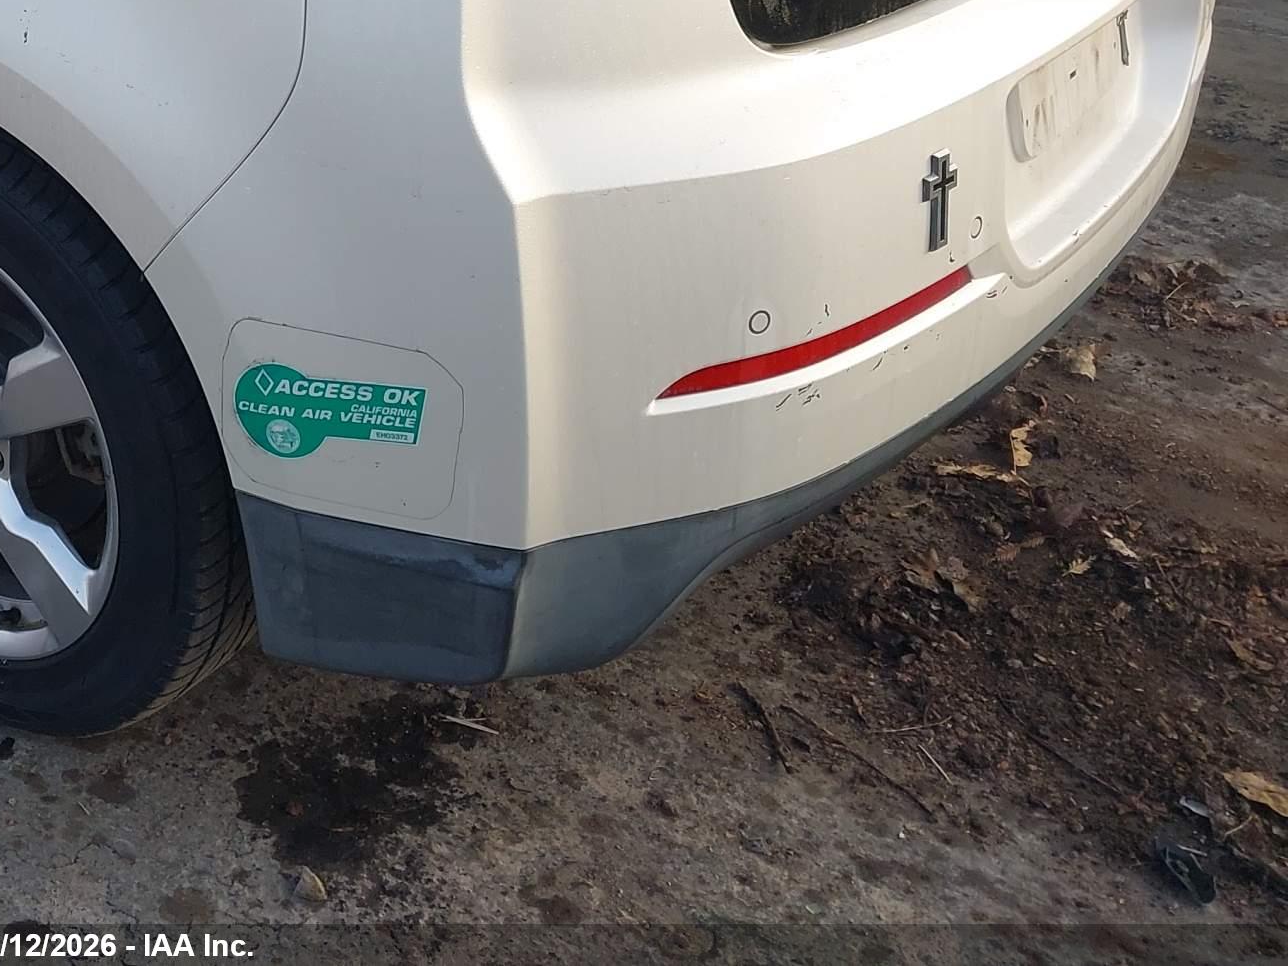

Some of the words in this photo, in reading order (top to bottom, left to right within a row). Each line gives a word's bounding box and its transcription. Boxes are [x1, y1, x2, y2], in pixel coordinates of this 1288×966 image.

[274, 379, 373, 402] ACCESS
[383, 388, 420, 406] OK
[238, 401, 295, 417] CLEAN
[301, 409, 332, 420] AIR
[340, 412, 417, 428] VEHICLE
[351, 404, 417, 418] CALIFORNIA
